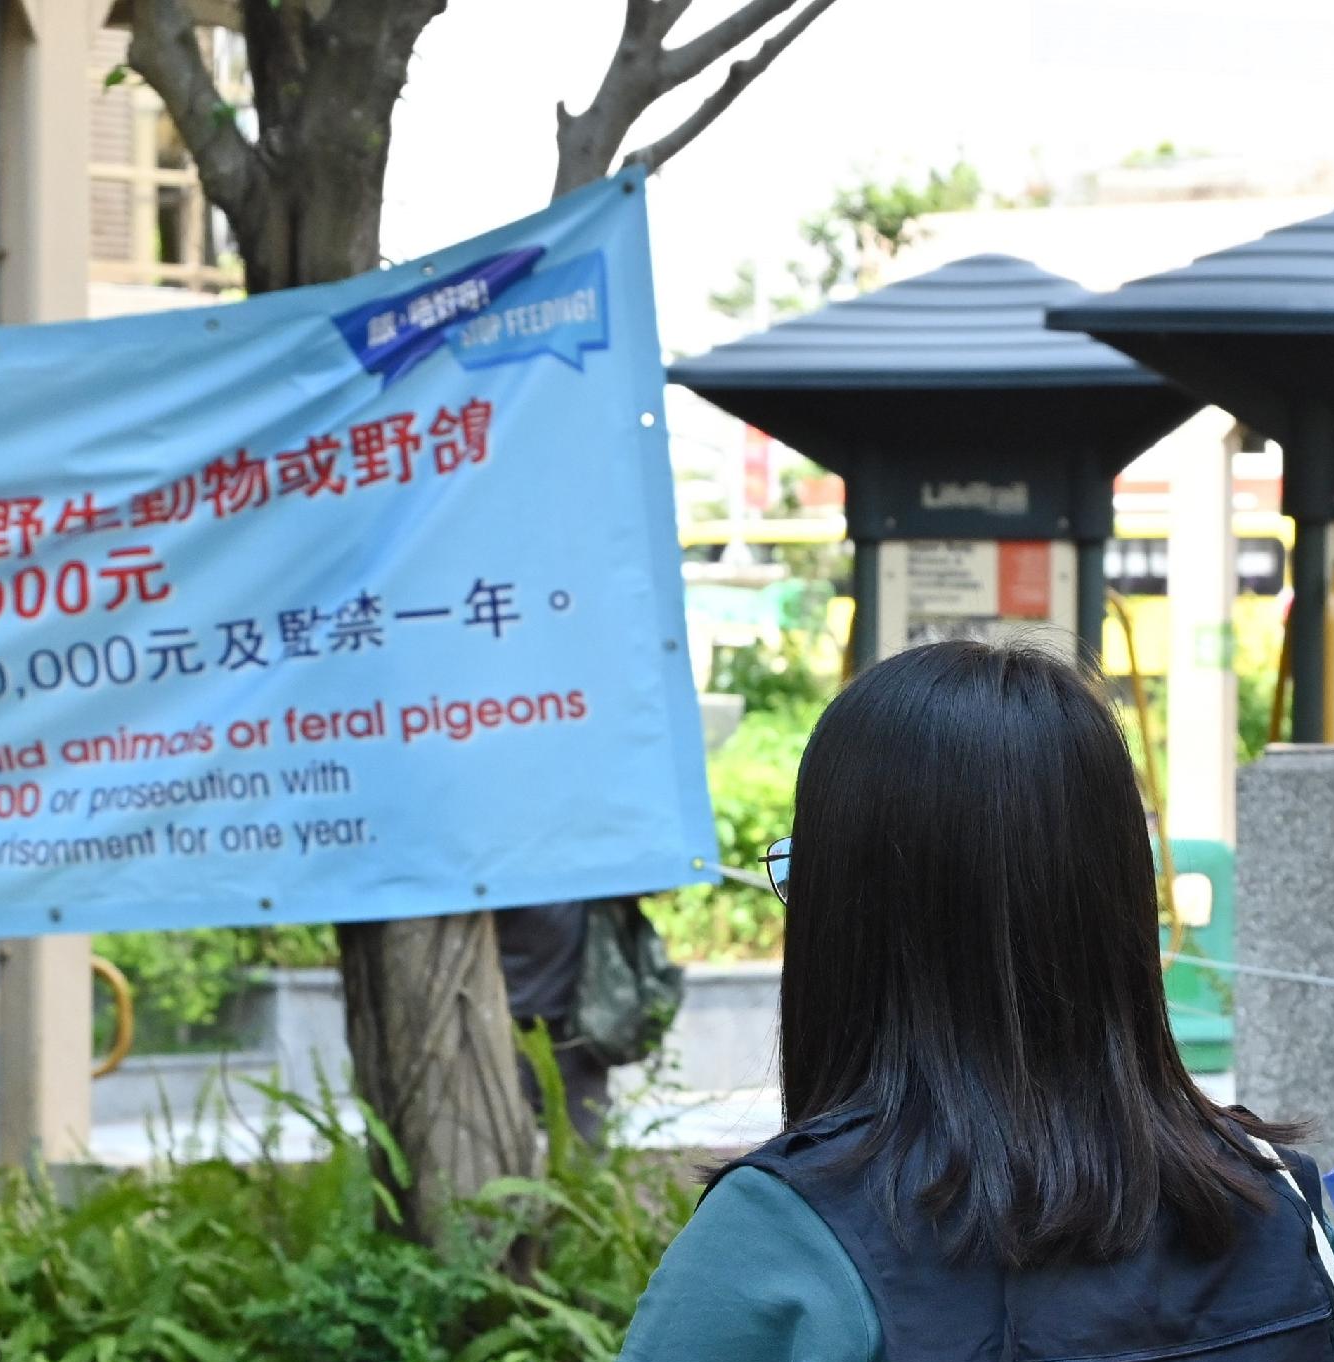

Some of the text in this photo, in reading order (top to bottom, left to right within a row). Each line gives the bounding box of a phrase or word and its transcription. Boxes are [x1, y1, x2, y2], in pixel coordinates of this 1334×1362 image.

[61, 722, 214, 765] animals
[227, 719, 269, 749] or
[285, 701, 386, 743] feral
[400, 689, 588, 743] pigeons
[49, 788, 80, 815] or
[87, 769, 271, 816] prosecution
[281, 760, 351, 796] with
[166, 821, 208, 855] for
[219, 822, 284, 852] one
[293, 817, 378, 856] year.
